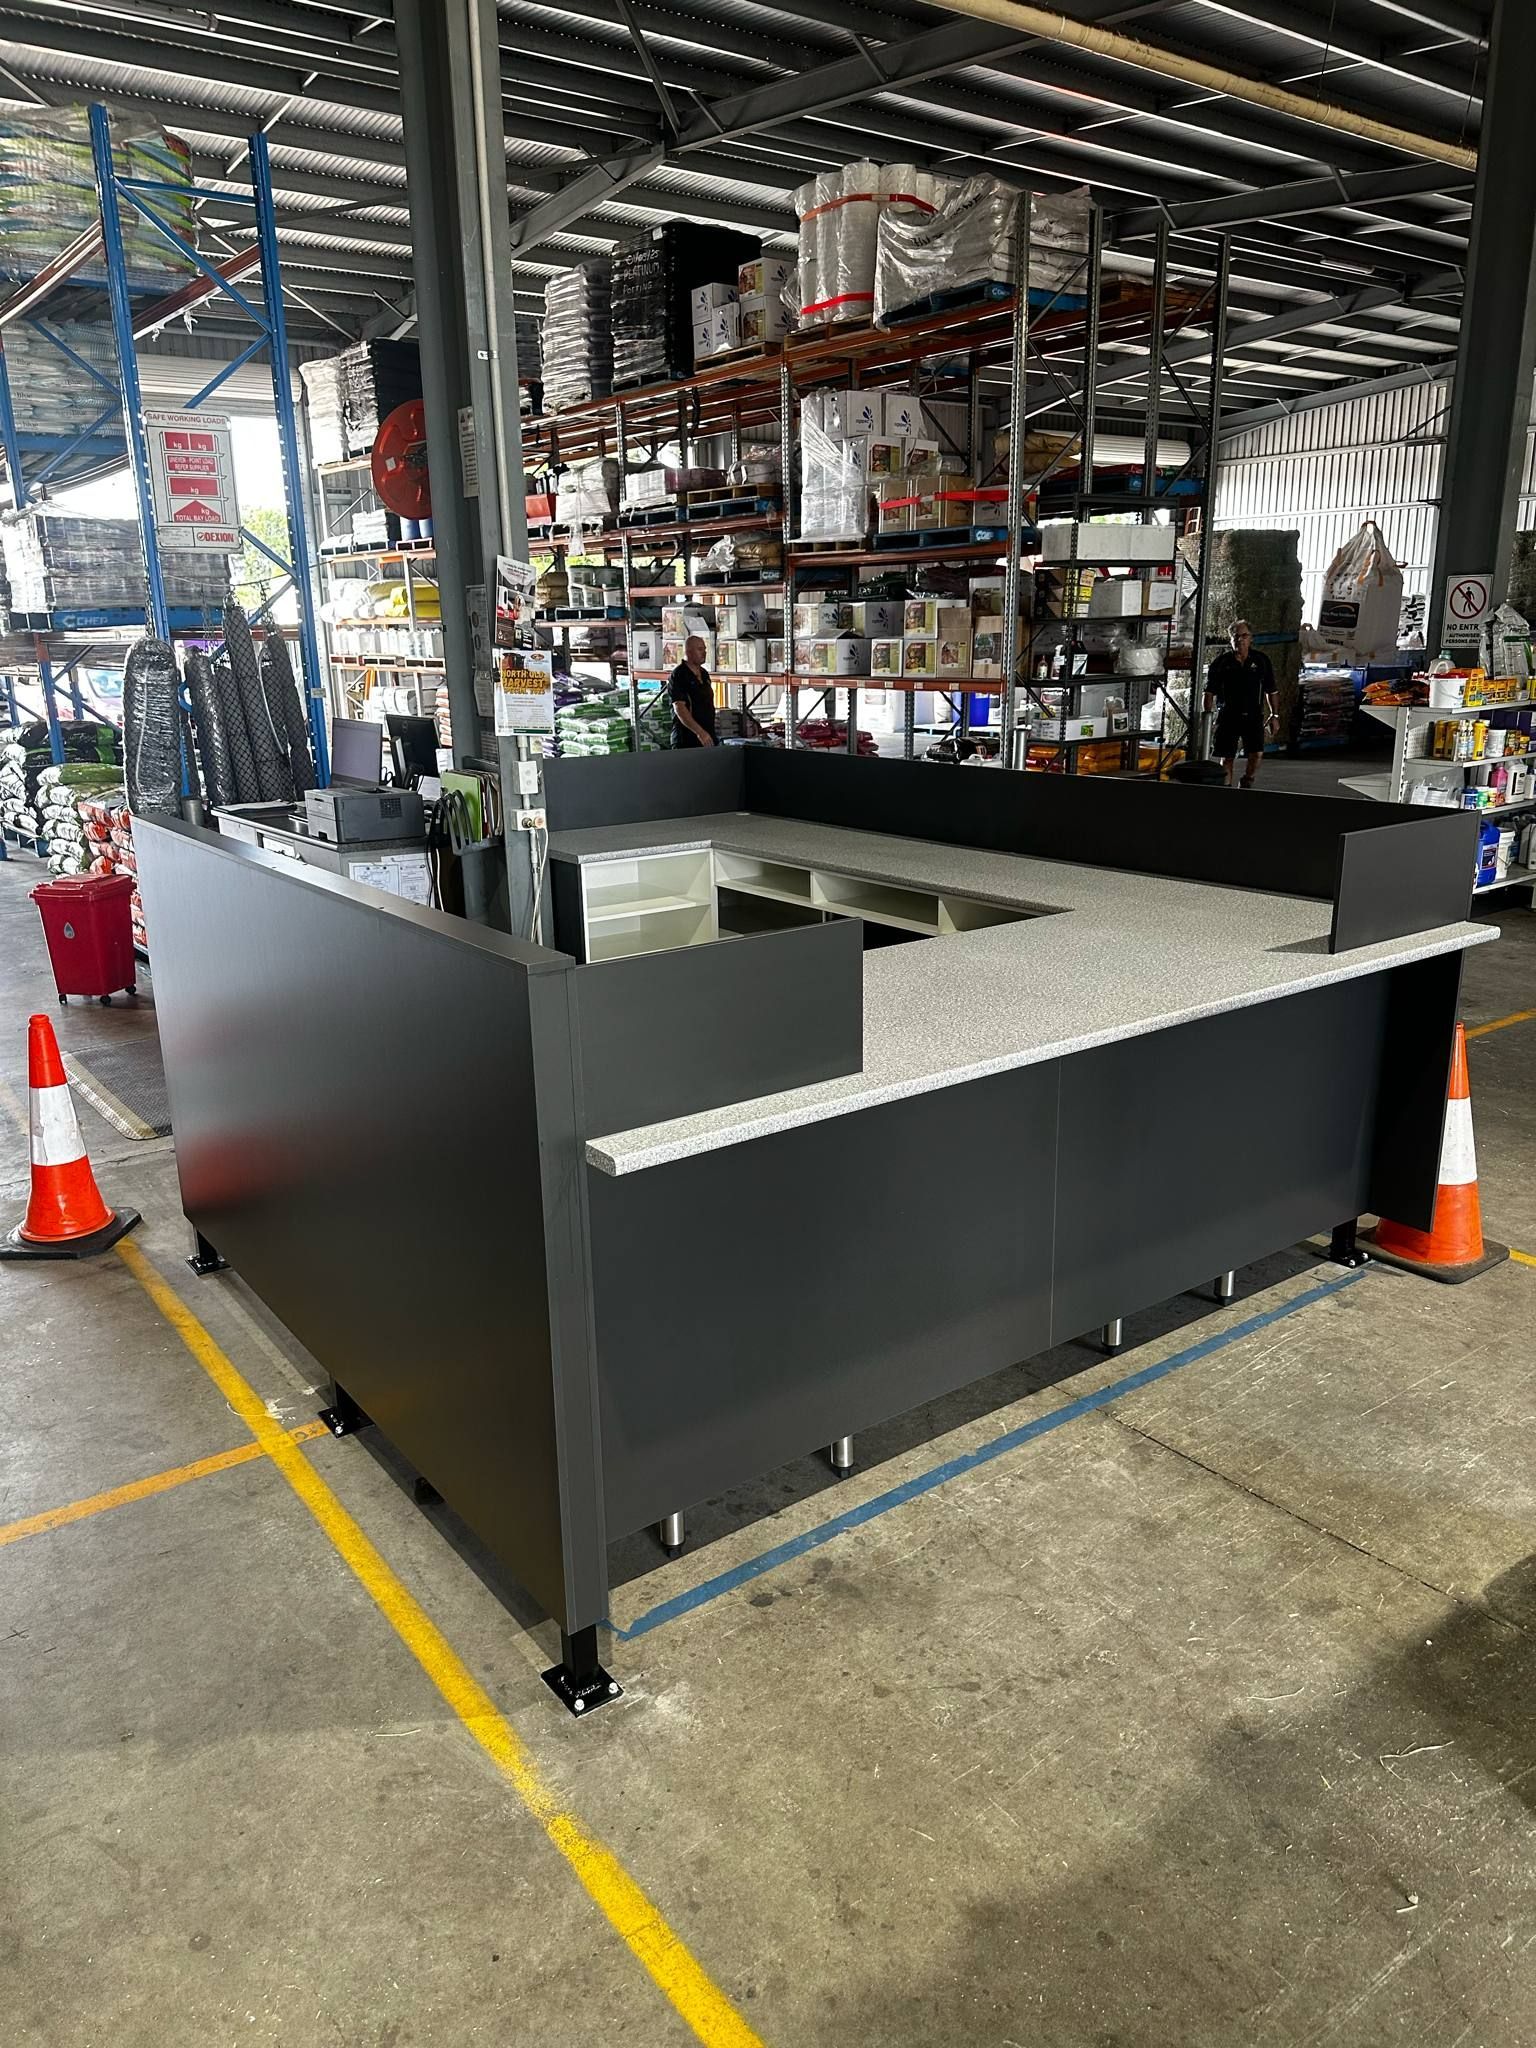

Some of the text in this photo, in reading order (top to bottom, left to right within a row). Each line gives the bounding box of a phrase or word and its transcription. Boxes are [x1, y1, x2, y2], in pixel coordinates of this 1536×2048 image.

[147, 413, 166, 421] SAFE
[167, 414, 202, 423] WORKING
[202, 417, 226, 425] LOADS
[198, 443, 207, 451] kg
[175, 514, 192, 522] TOTAL
[204, 532, 234, 543] DEXION
[76, 616, 108, 626] CHEP
[1446, 623, 1480, 631] NO ENTR
[502, 669, 527, 679] NORTH
[502, 678, 544, 688] HARVEST
